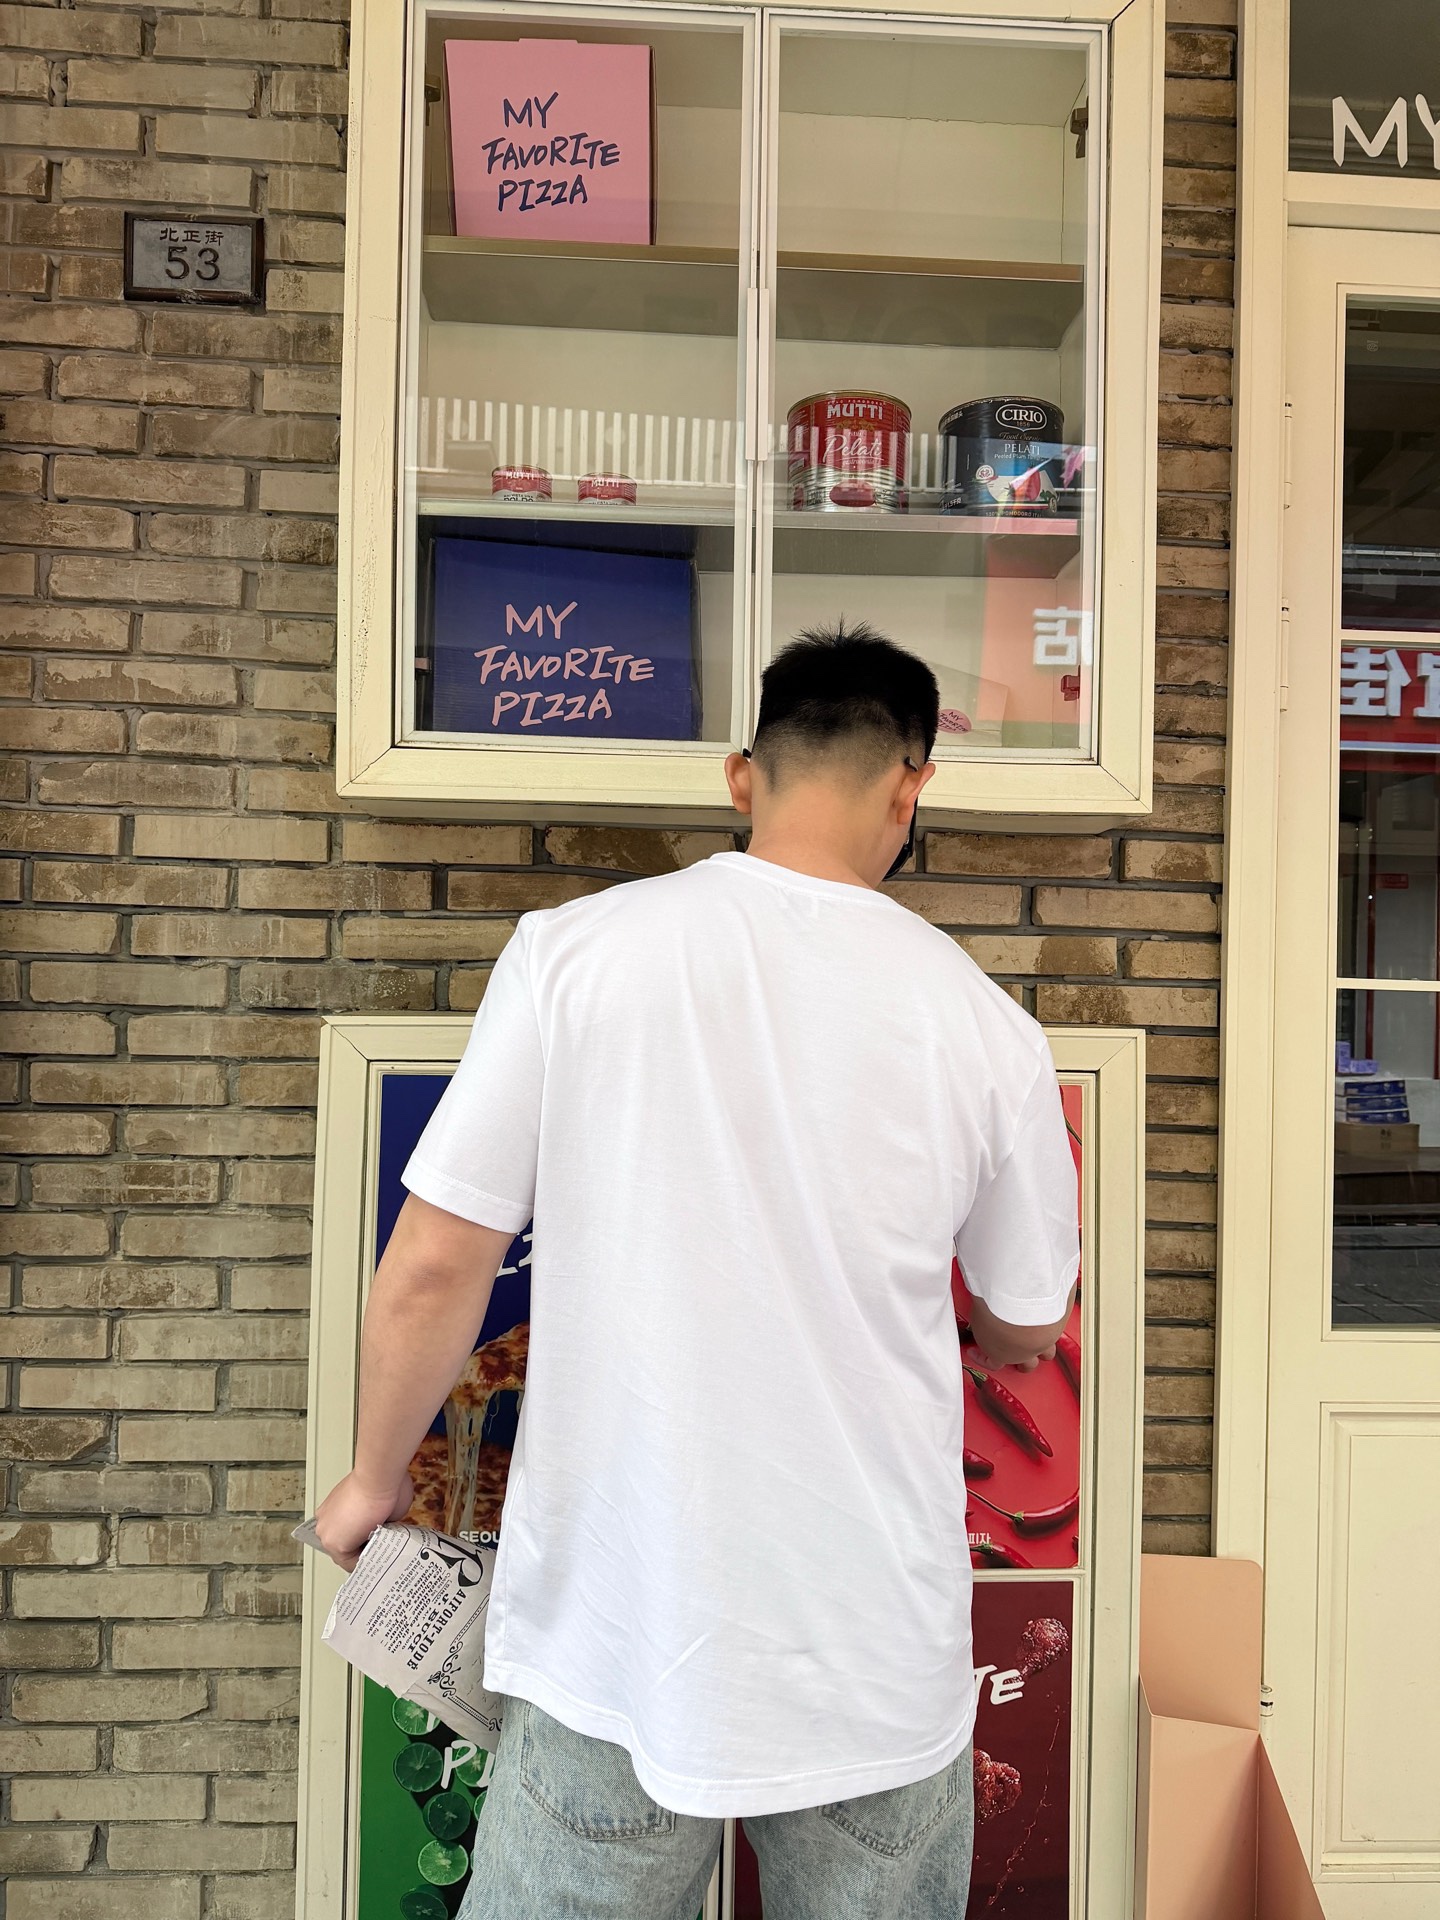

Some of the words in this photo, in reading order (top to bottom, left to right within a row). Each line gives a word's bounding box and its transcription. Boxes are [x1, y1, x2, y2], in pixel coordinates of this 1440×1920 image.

[503, 92, 559, 128] MY
[482, 132, 620, 174] FAVORITE
[498, 174, 588, 211] PIZZA
[160, 228, 224, 245] 北正街
[165, 246, 220, 280] 53
[827, 403, 883, 420] MUTTI
[1001, 409, 1043, 423] CIRIO
[822, 434, 882, 463] Pelati
[1004, 443, 1040, 455] PELATI
[505, 471, 535, 481] MUTTI
[592, 478, 620, 488] MUTTI
[506, 601, 578, 639] MY
[474, 645, 655, 685] FAVORITE
[492, 688, 612, 727] PIZZA
[968, 1532, 992, 1544] 피자
[437, 1592, 449, 1605] J.
[407, 1608, 439, 1652] BUCI
